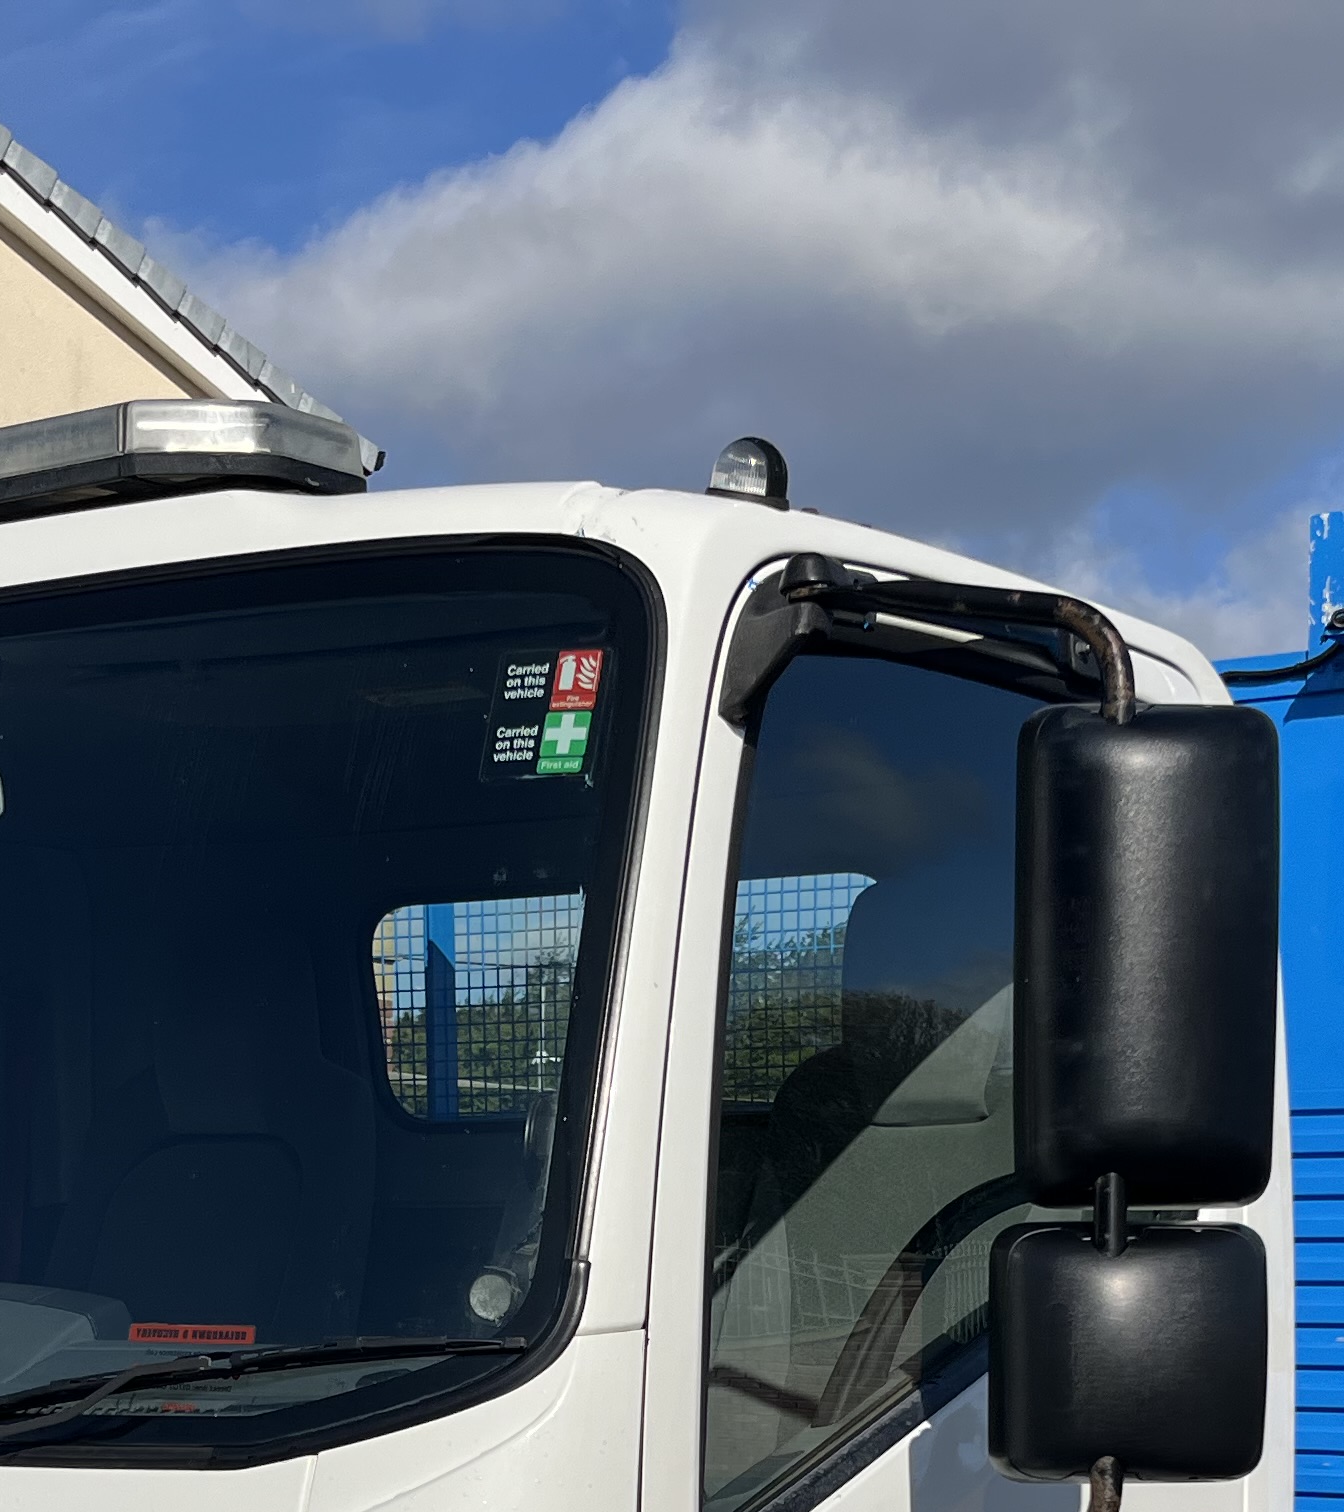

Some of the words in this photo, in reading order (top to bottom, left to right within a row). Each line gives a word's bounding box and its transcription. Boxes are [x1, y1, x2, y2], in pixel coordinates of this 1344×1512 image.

[507, 662, 550, 676] Carried
[506, 678, 521, 688] on
[524, 675, 546, 687] this
[503, 687, 545, 700] vehicle
[496, 725, 539, 739] Carried
[495, 740, 510, 751] on
[513, 737, 535, 749] this
[493, 749, 534, 762] vehicle
[541, 761, 562, 770] First
[563, 760, 579, 769] aid
